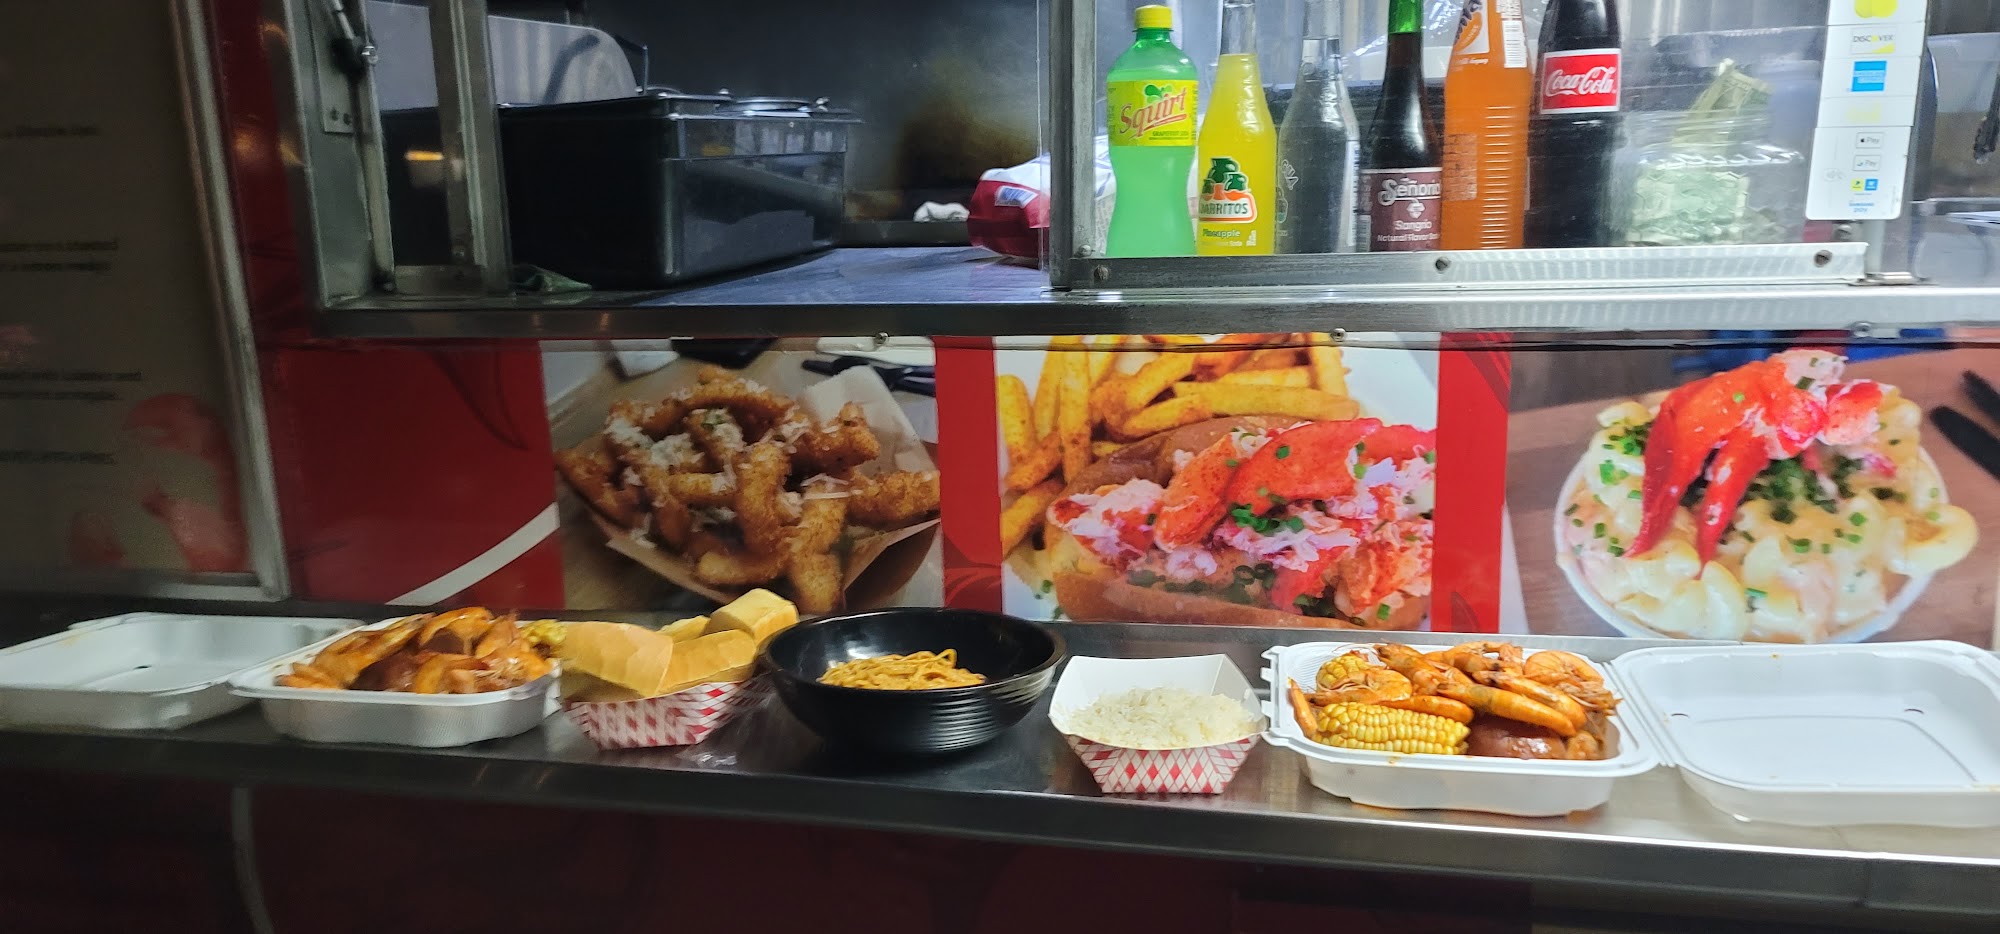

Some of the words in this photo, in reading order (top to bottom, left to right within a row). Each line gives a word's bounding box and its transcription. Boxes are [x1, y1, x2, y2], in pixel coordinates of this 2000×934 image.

[1853, 34, 1894, 42] DISCOVER
[1545, 66, 1617, 97] Coca-Cola
[1120, 87, 1187, 138] Squirt
[1200, 202, 1248, 214] ARRITOS
[1202, 228, 1240, 239] Pineapple
